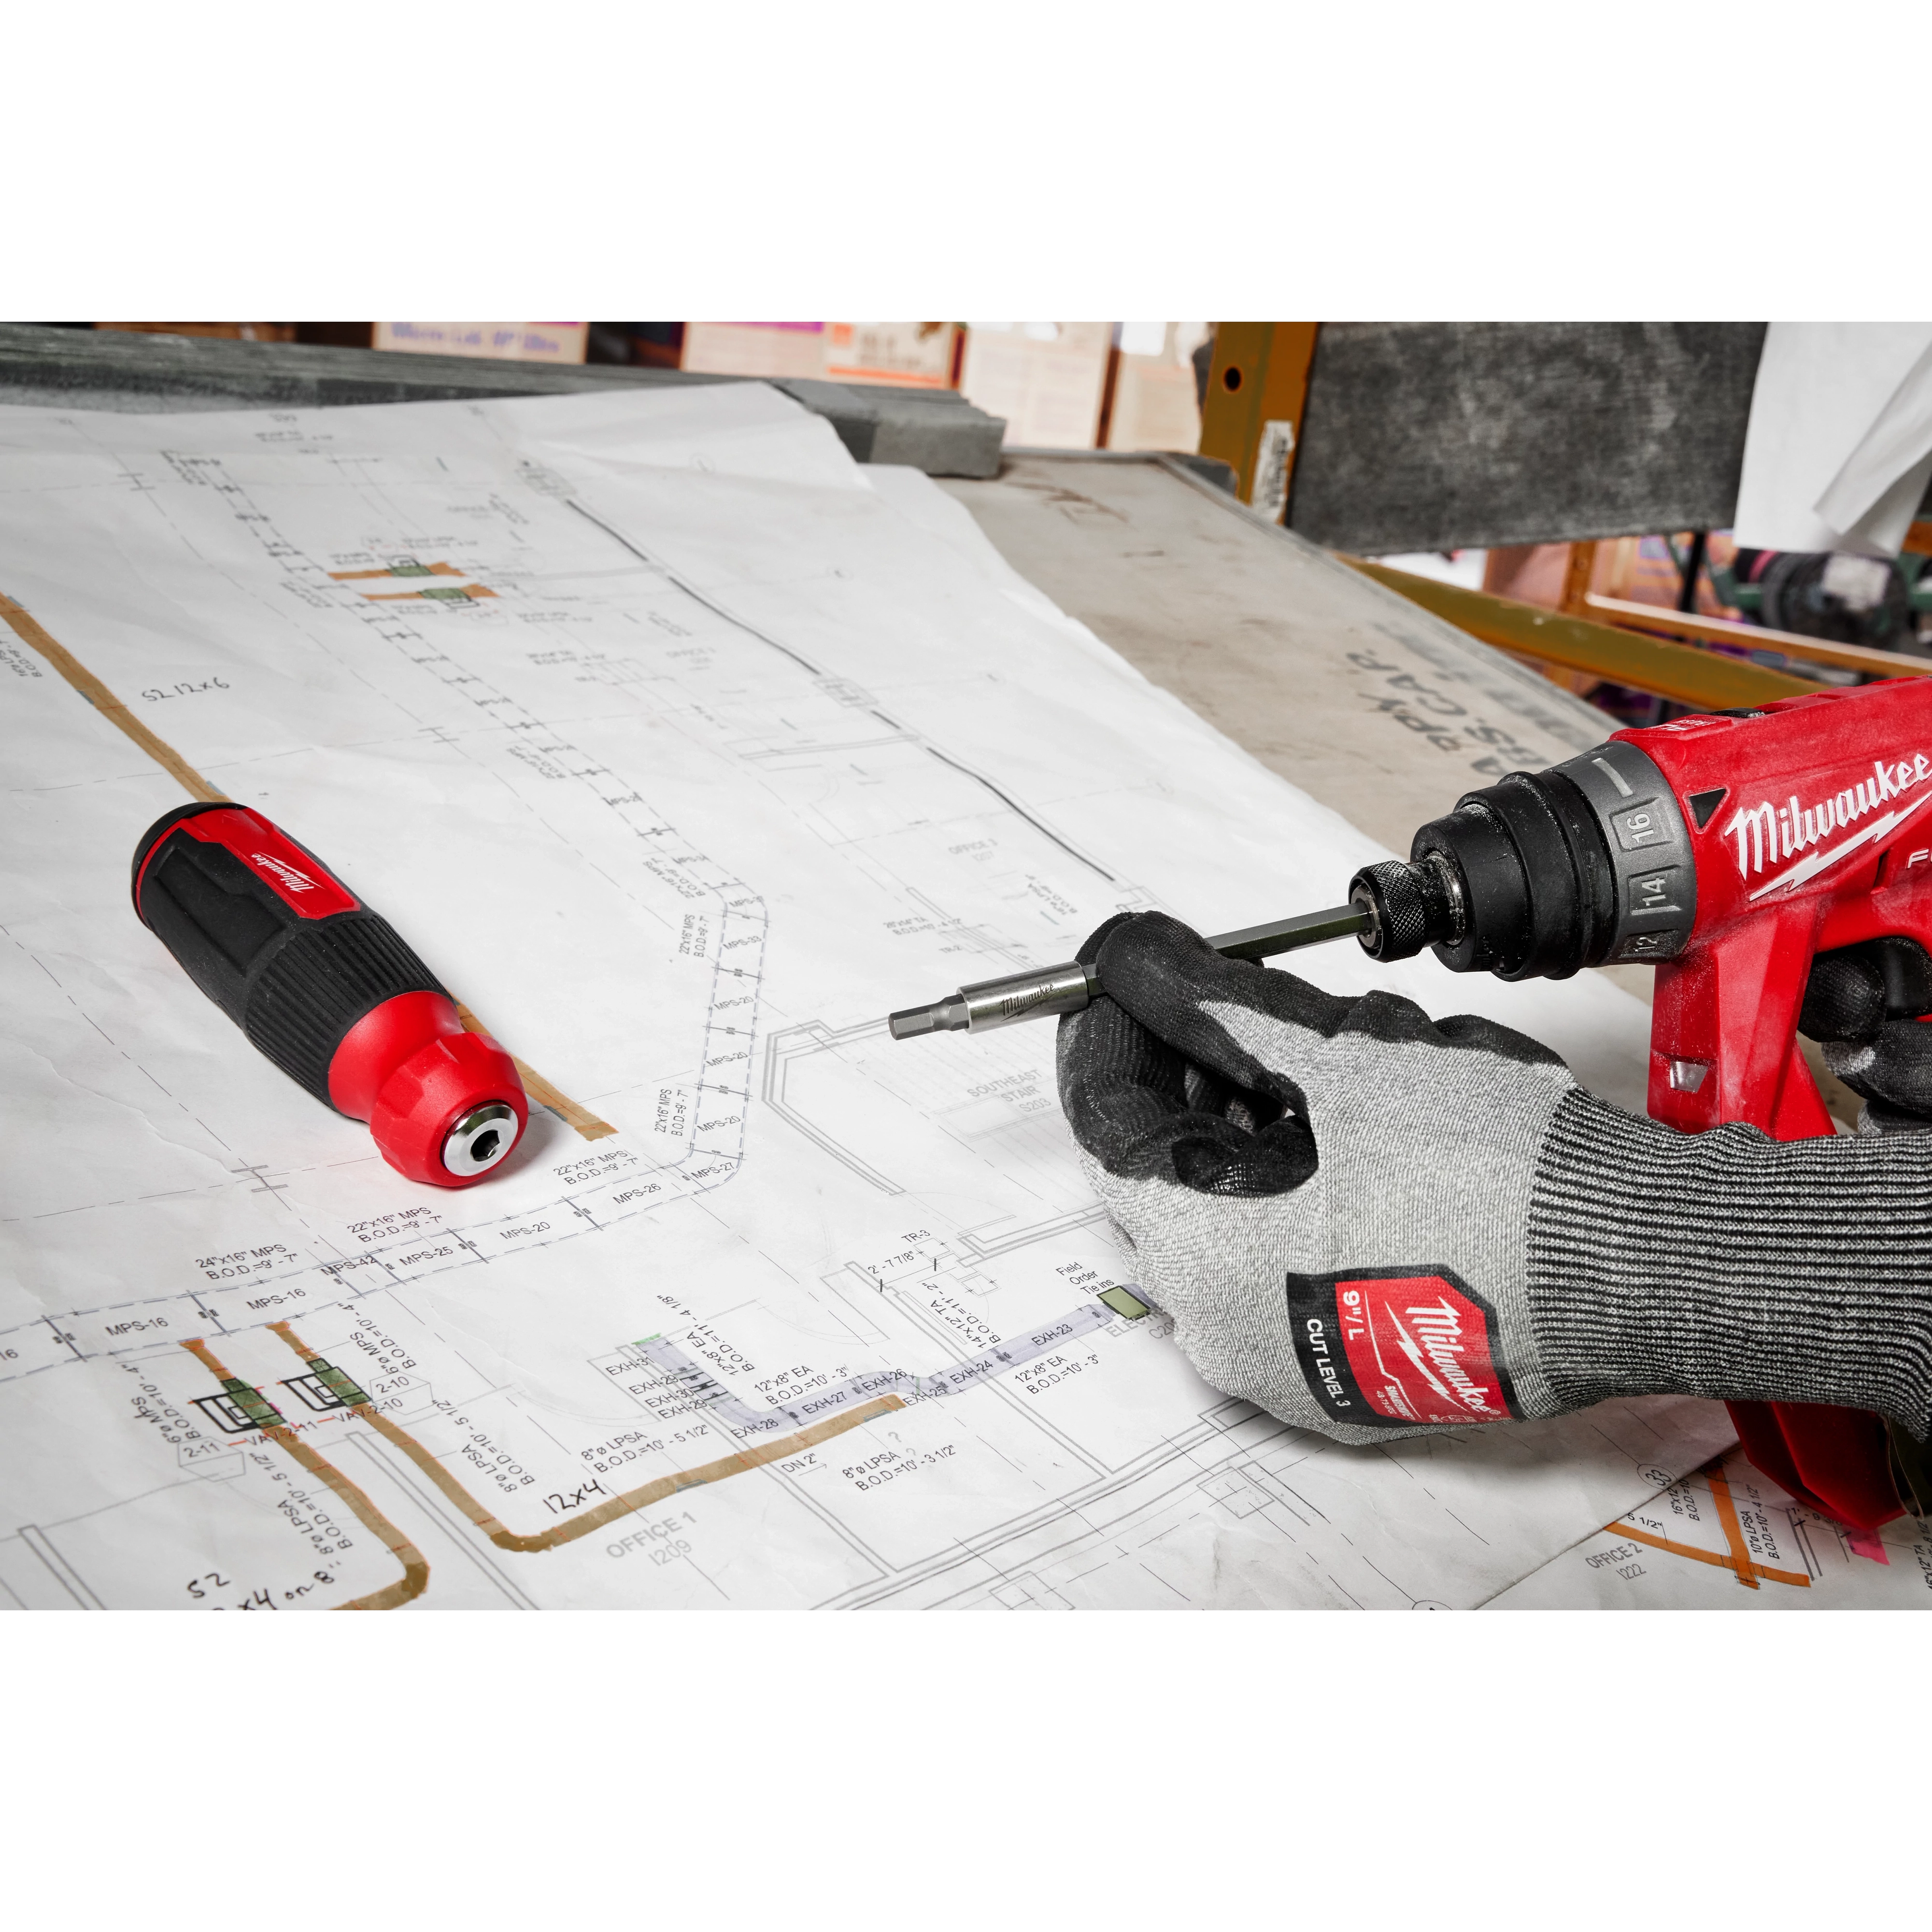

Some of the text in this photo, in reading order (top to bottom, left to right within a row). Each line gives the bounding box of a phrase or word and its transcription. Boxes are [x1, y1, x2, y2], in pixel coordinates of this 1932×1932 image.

[1627, 813, 1652, 843] 16
[1725, 753, 1932, 881] Milwaukee
[1907, 849, 1932, 868] F
[251, 853, 314, 894] Milwaukee
[1641, 874, 1666, 906] 14
[683, 914, 695, 928] MPS
[723, 936, 762, 950] MPS-33
[713, 996, 753, 1010] MPS-20
[999, 984, 1054, 1016] Milwaukee
[706, 1052, 748, 1067] MPS-20
[967, 1070, 1042, 1097] SOUTHEAST
[1001, 1085, 1040, 1102] STAIR
[654, 1089, 672, 1133] 22"x16" MPS
[1019, 1098, 1051, 1112] S203
[697, 1116, 741, 1132] MPS-20
[553, 1151, 628, 1177] 22"x16" MPS
[564, 1157, 639, 1185] B.O.D.=9' 7"
[691, 1163, 735, 1180] MPS-27
[612, 1183, 661, 1204] MPS-26
[347, 1207, 431, 1234] 22"x16" MPS
[358, 1215, 442, 1243] B.O.D.=9' 7"
[500, 1221, 551, 1240] MPS-20
[901, 1230, 930, 1243] TR-3
[195, 1244, 286, 1269] 24"x16" MPS
[207, 1253, 298, 1280] B.O.D.=9' 7"
[321, 1255, 376, 1276] MPS-42
[399, 1246, 454, 1266] MPS-25
[867, 1251, 914, 1275] 2' 7 7/8"
[1055, 1261, 1083, 1276] Field
[1069, 1270, 1099, 1286] Order
[1080, 1279, 1114, 1295] Tie ins
[246, 1288, 306, 1310] MPS-16
[930, 1300, 947, 1315] TA
[105, 1317, 169, 1336] MPS-16
[1031, 1324, 1074, 1347] EXH-23
[1307, 1319, 1328, 1354] CUT
[350, 1331, 382, 1356] MPS
[686, 1331, 706, 1348] EA
[605, 1355, 655, 1376] EXH-31
[1405, 1297, 1489, 1413] Milwaukee
[753, 1365, 813, 1393] 12"x8" EA
[950, 1360, 994, 1385] EXH-24
[1015, 1355, 1068, 1383] 12"x8" EA
[1026, 1354, 1098, 1394] B.O.D.=10' 3"
[1316, 1358, 1344, 1398] LEVEL
[375, 1376, 410, 1393] 2-10
[629, 1375, 678, 1395] EXH-29
[766, 1373, 829, 1405] B.O.D.=10'
[862, 1369, 907, 1392] EXH-26
[645, 1388, 694, 1408] EXH-30
[801, 1392, 847, 1414] EXH-27
[903, 1386, 948, 1406] EXH-25
[131, 1397, 161, 1423] MPS
[657, 1399, 707, 1419] EXH-29
[731, 1418, 779, 1438] EXH-28
[183, 1442, 221, 1458] 2-11
[594, 1424, 710, 1473] B.O.D.=10' 5 1/2"
[606, 1432, 648, 1450] LPSA
[461, 1443, 496, 1474] LPSA
[781, 1453, 816, 1474] DN 2"
[855, 1445, 956, 1491] B.O.D.=10' 3 1/2"
[863, 1451, 901, 1473] LPSA
[1646, 1470, 1672, 1486] 33
[1746, 1484, 1761, 1500] 1/2"
[278, 1500, 313, 1534] LPSA
[1639, 1517, 1662, 1529] 1/2"
[1740, 1511, 1757, 1534] LPSA
[607, 1512, 697, 1558] OFFICE 1
[1585, 1543, 1643, 1568] OFFICE 2
[1913, 1545, 1926, 1555] TA
[284, 1583, 313, 1600] on
